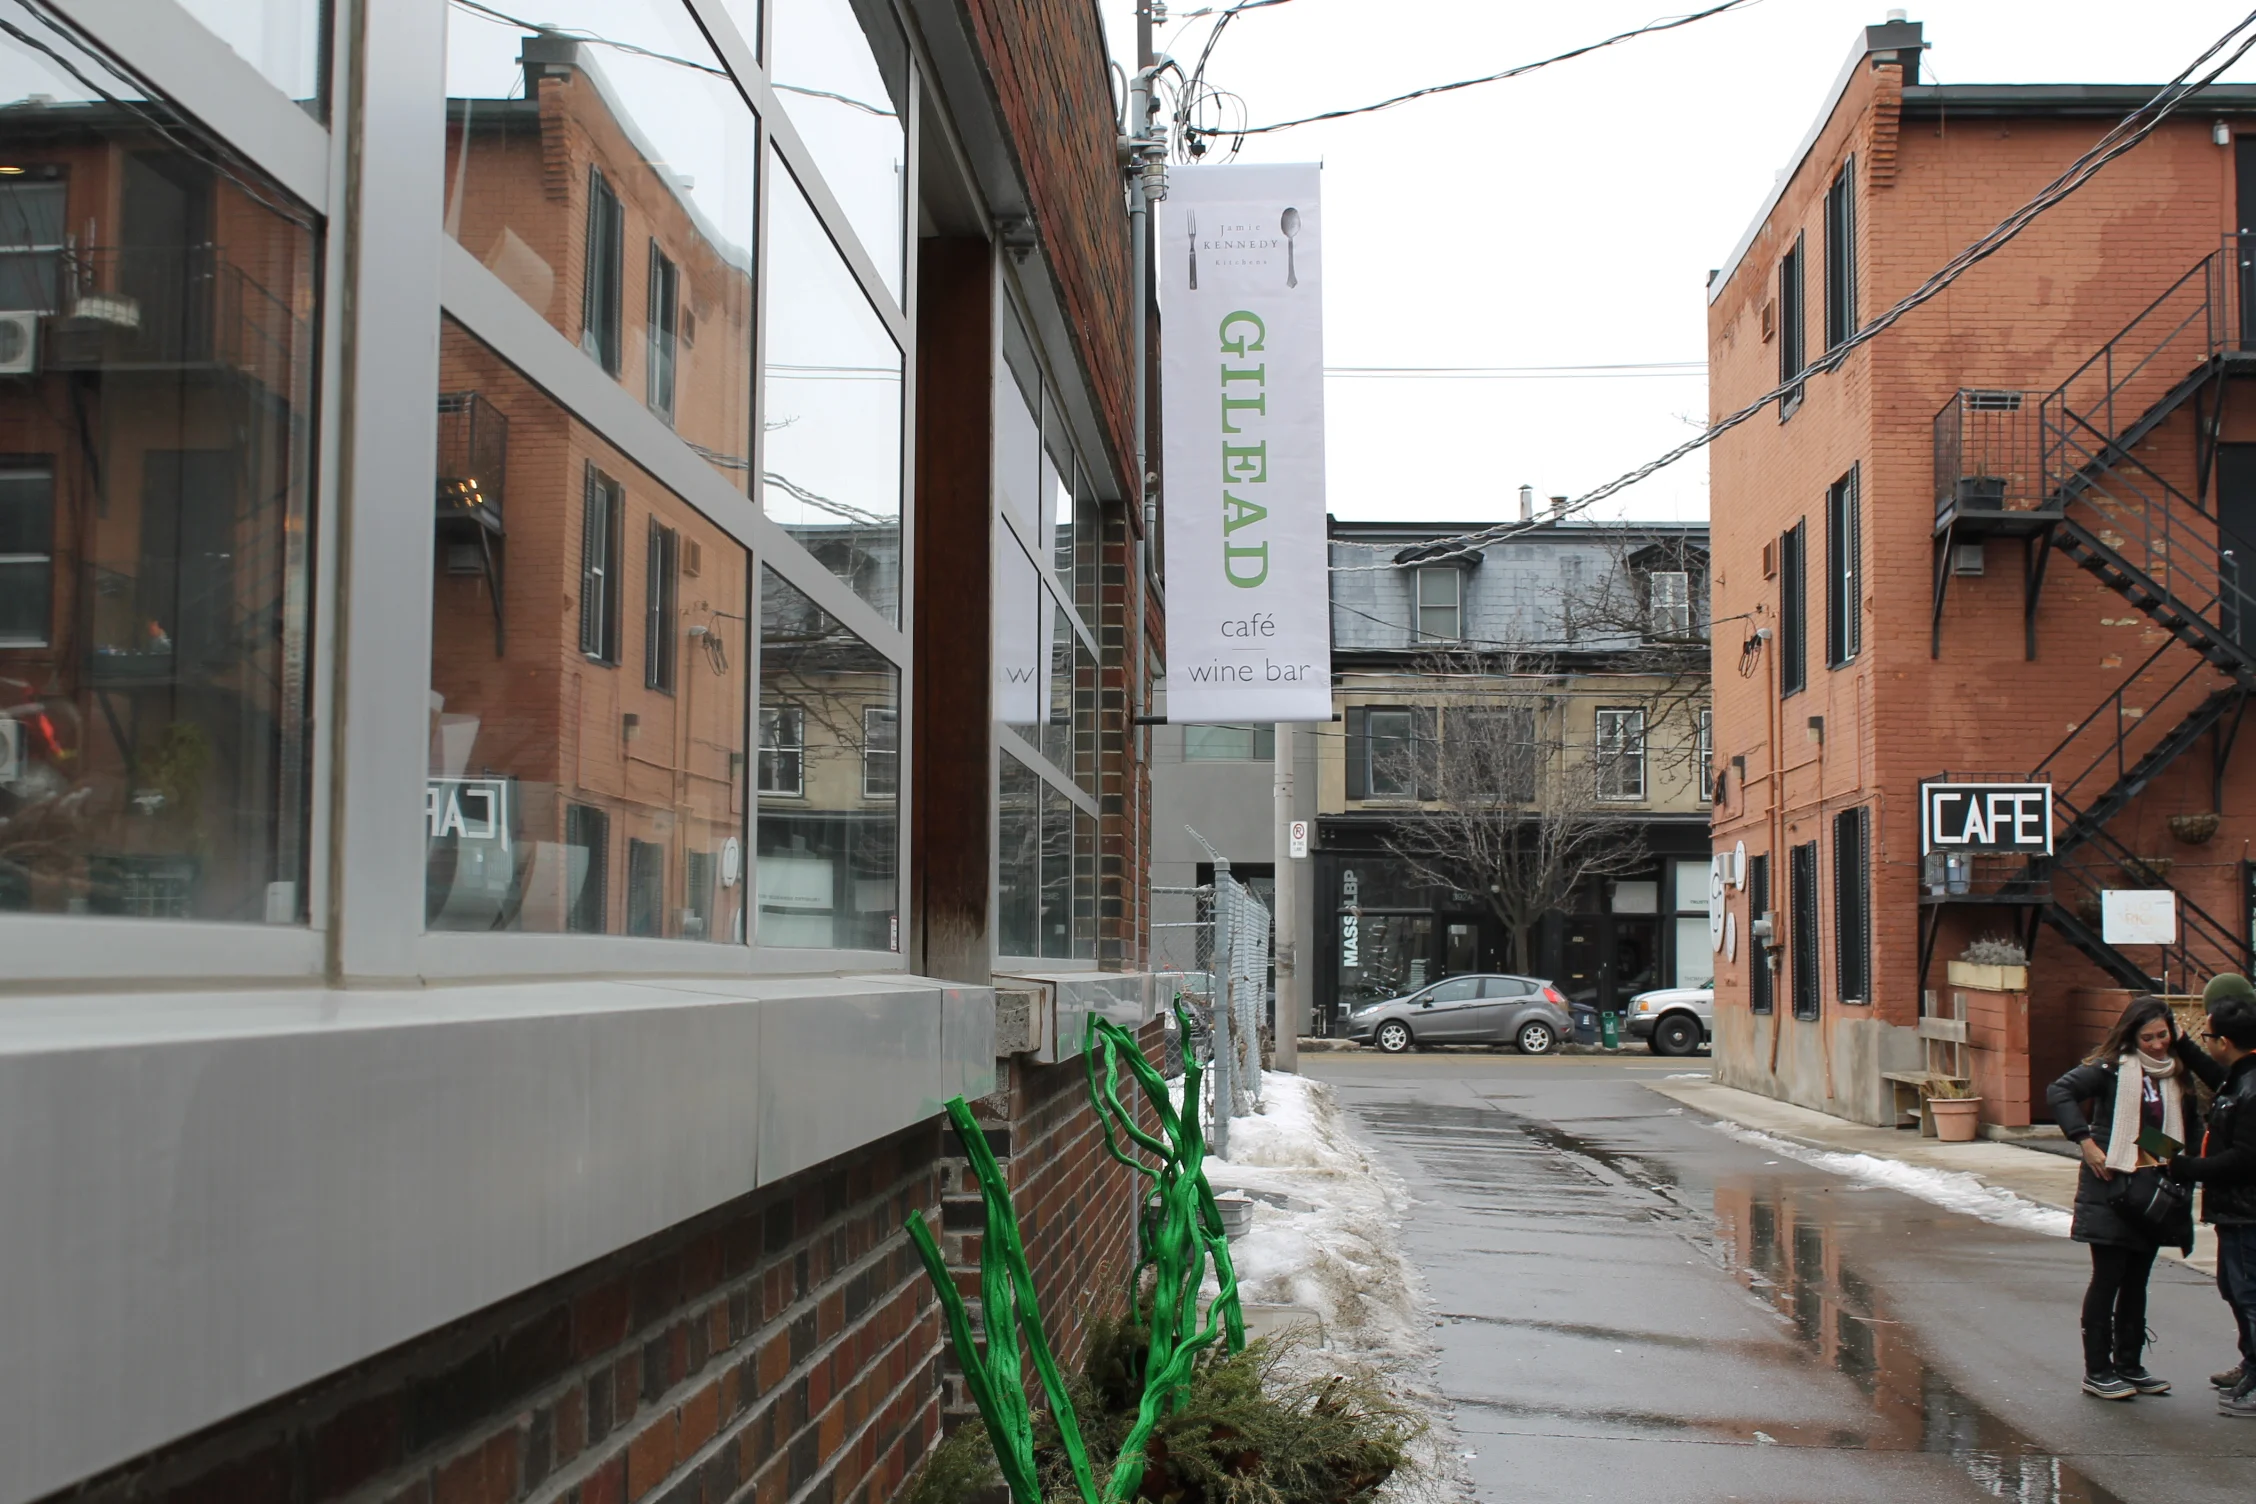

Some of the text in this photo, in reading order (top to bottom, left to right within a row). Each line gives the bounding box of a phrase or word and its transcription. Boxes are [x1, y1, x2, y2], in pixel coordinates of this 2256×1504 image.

[1220, 224, 1261, 237] Jamie
[1203, 239, 1279, 250] KENNEDY
[1219, 310, 1268, 588] GILEAD
[1221, 612, 1275, 637] café
[1187, 657, 1311, 682] wine bar
[1932, 793, 2043, 843] CAFE
